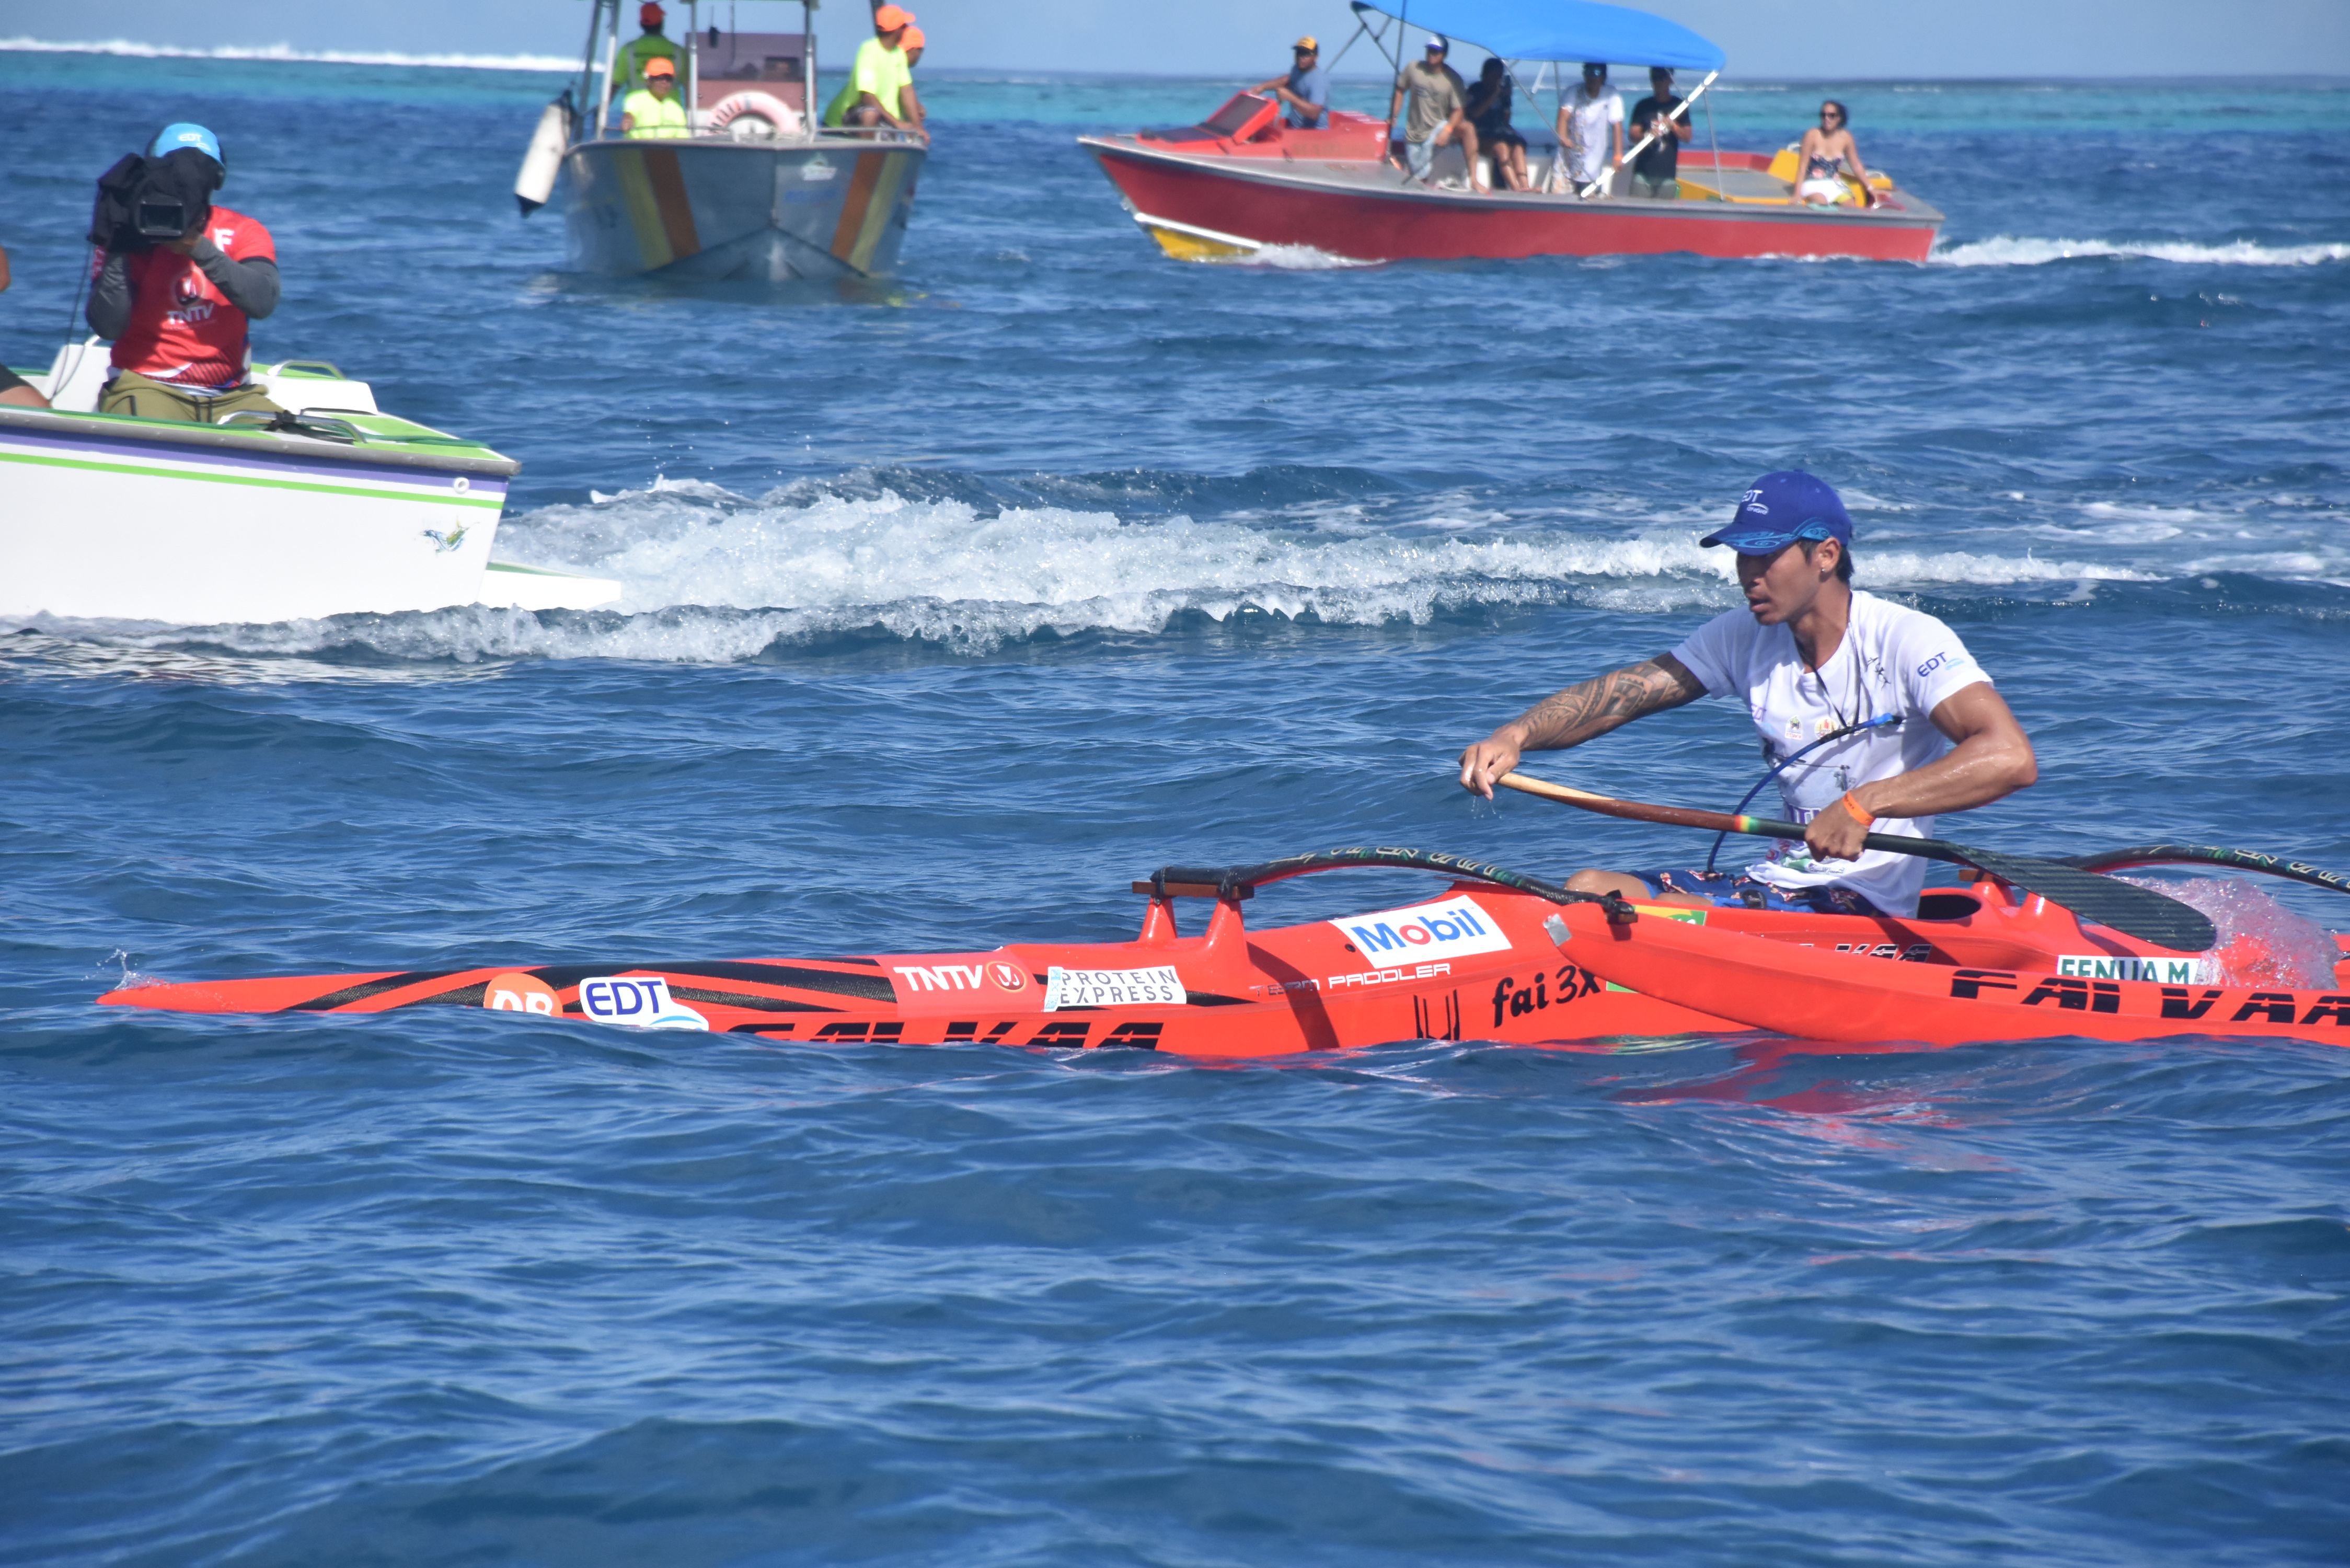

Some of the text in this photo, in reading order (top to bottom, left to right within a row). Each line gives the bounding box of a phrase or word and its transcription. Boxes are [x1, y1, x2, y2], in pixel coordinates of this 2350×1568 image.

[179, 133, 203, 142] EDT
[167, 303, 214, 325] TNTV
[1917, 652, 1946, 677] EDT
[1350, 908, 1487, 952] Mobil
[893, 965, 983, 991] TNTV
[1062, 969, 1177, 985] PROTEIN
[1249, 963, 1450, 997] TEAM PADDLER
[585, 981, 662, 1016] EDT
[1060, 985, 1173, 1004] EXPRESS
[1492, 972, 1549, 1029] fai
[1950, 970, 2350, 1027] FAI VAA
